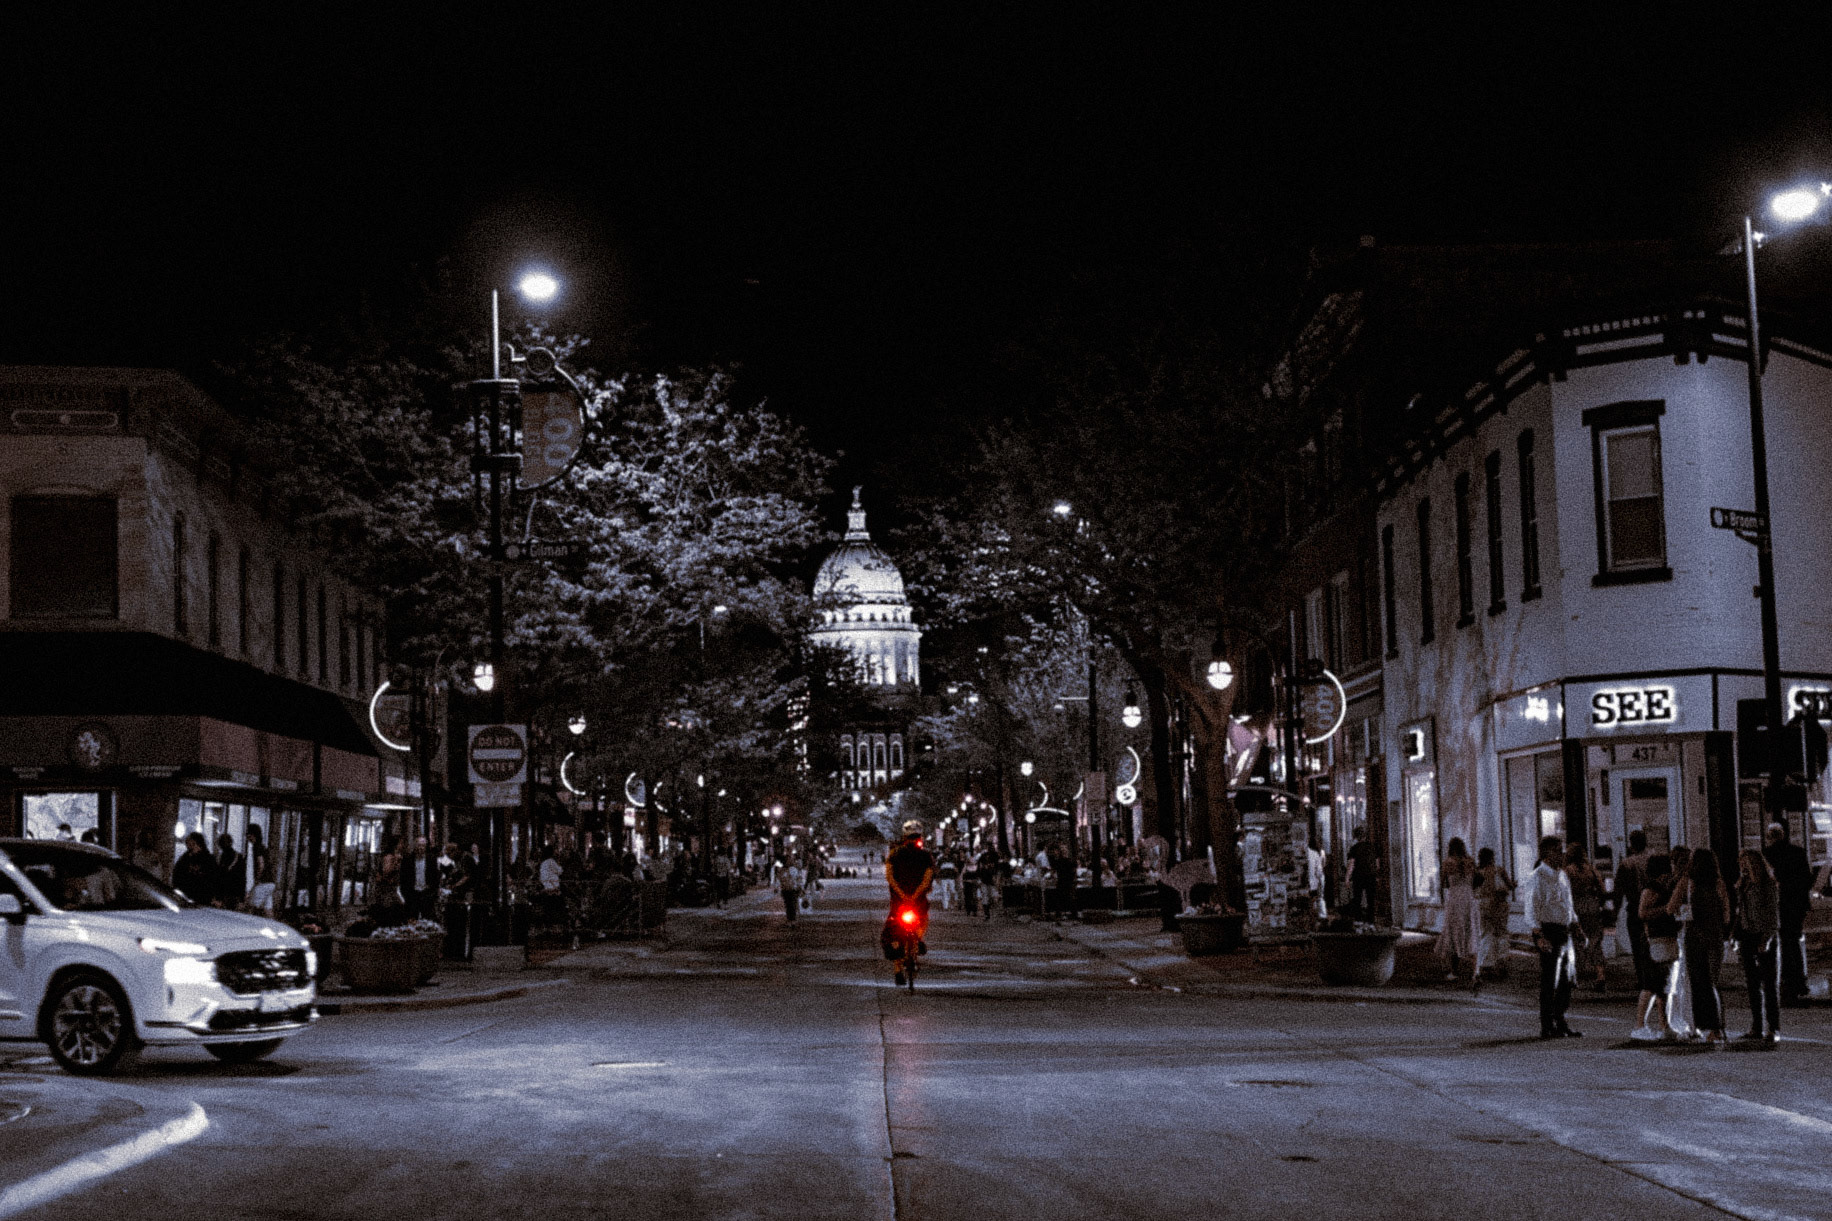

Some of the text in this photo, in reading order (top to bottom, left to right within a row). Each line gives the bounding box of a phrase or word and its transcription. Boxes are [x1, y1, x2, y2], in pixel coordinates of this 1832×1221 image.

[530, 544, 568, 557] Gilman
[1592, 689, 1672, 724] SEE
[478, 736, 515, 747] DO NOT
[1632, 747, 1656, 760] 437
[479, 762, 515, 772] ENTER
